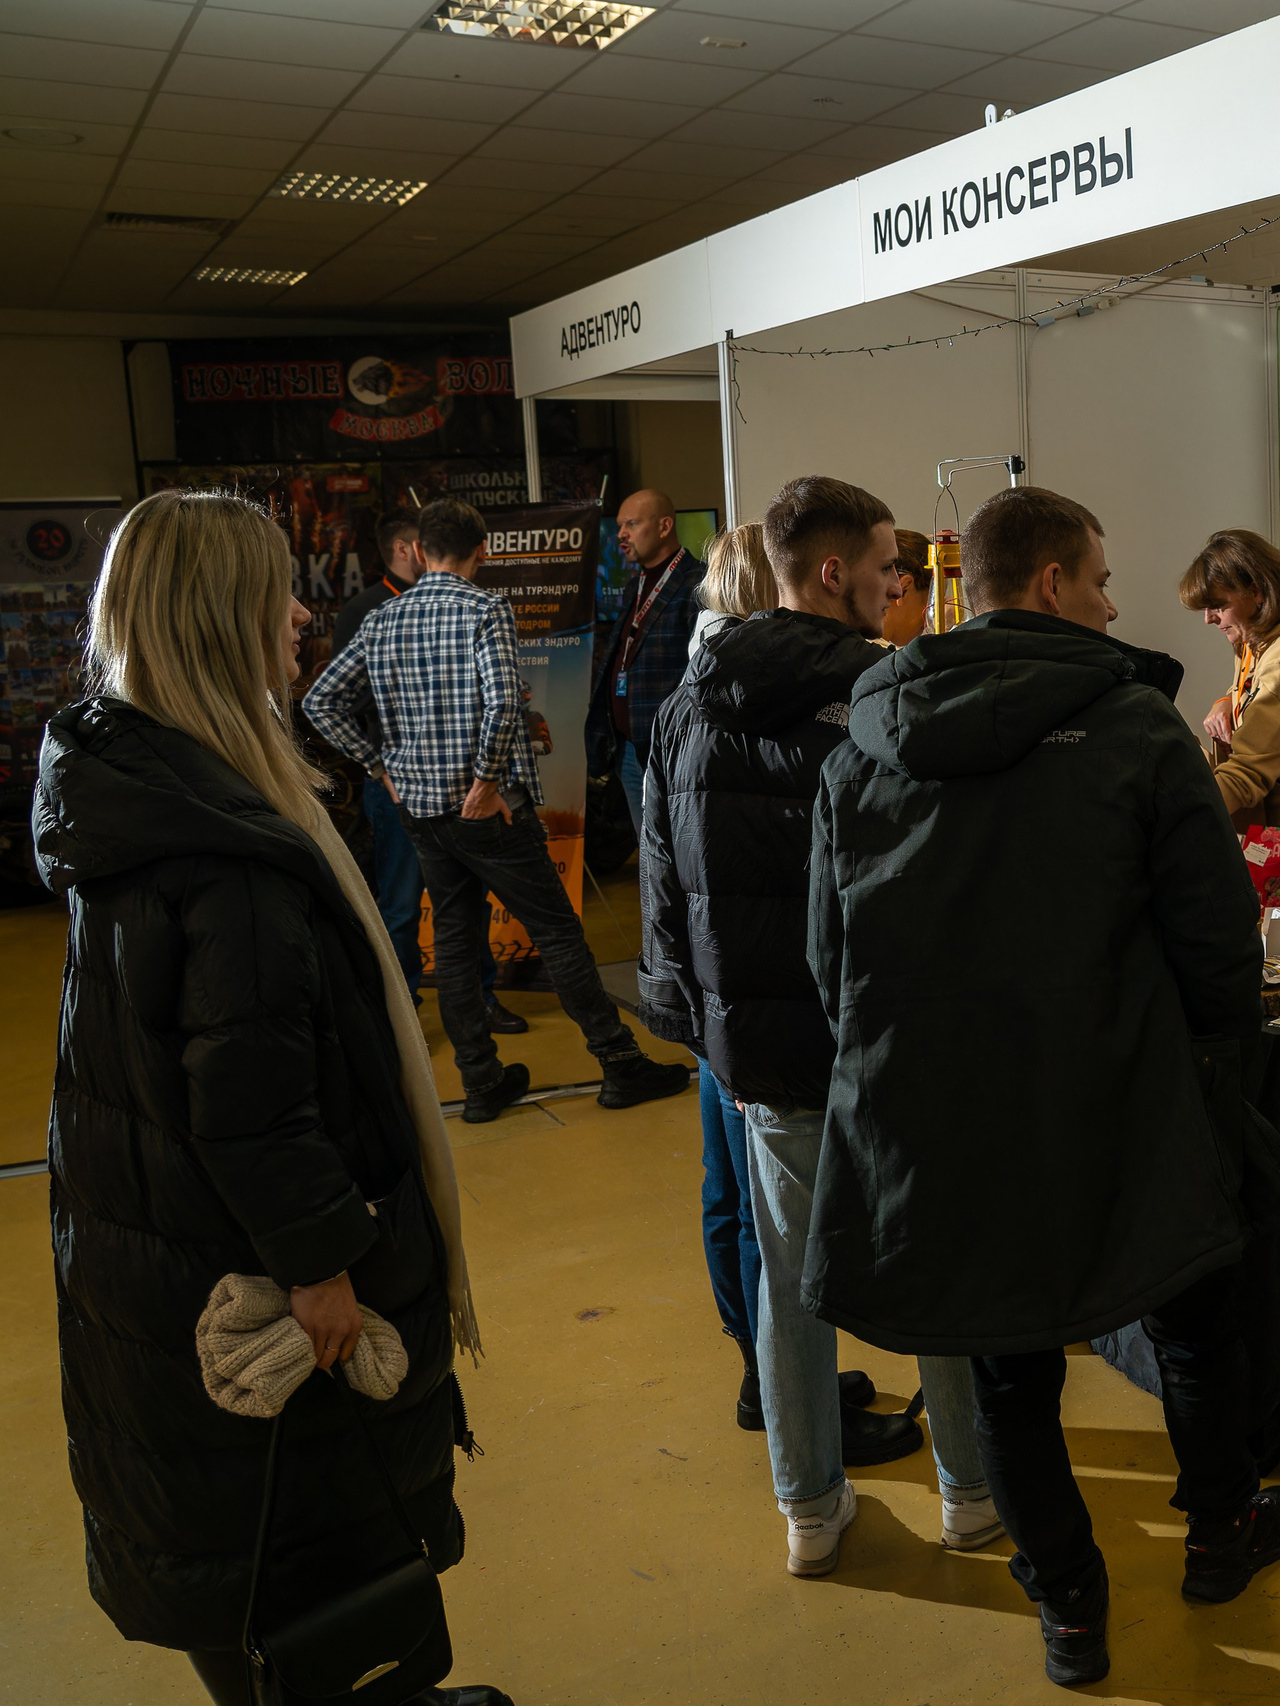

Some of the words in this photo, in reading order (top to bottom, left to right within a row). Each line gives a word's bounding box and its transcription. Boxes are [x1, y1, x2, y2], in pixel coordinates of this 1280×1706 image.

[873, 195, 933, 254] МОИ
[941, 126, 1133, 236] КОНСЕРВЫ
[560, 300, 641, 360] АДВЕНТУРО
[186, 363, 341, 399] НОЧНЫЕ
[445, 359, 514, 394] ВОЛ
[341, 411, 436, 440] МОСКВА
[541, 556, 550, 564] НЕ
[550, 555, 582, 564] КАЖДОМУ
[511, 586, 524, 596] НА
[526, 584, 579, 596] ТУРЭНДУРО
[525, 603, 560, 614] РОССИИ
[515, 619, 551, 631] ТОДРОМ
[518, 638, 542, 648] СКИХ
[544, 636, 581, 648] ЭНДУРО
[516, 656, 549, 666] ЕСТВИЯ
[818, 707, 841, 717] RTH
[814, 713, 839, 725] FACE
[1041, 736, 1075, 744] RTH
[944, 1498, 964, 1507] bok
[795, 1522, 825, 1531] Reebok
